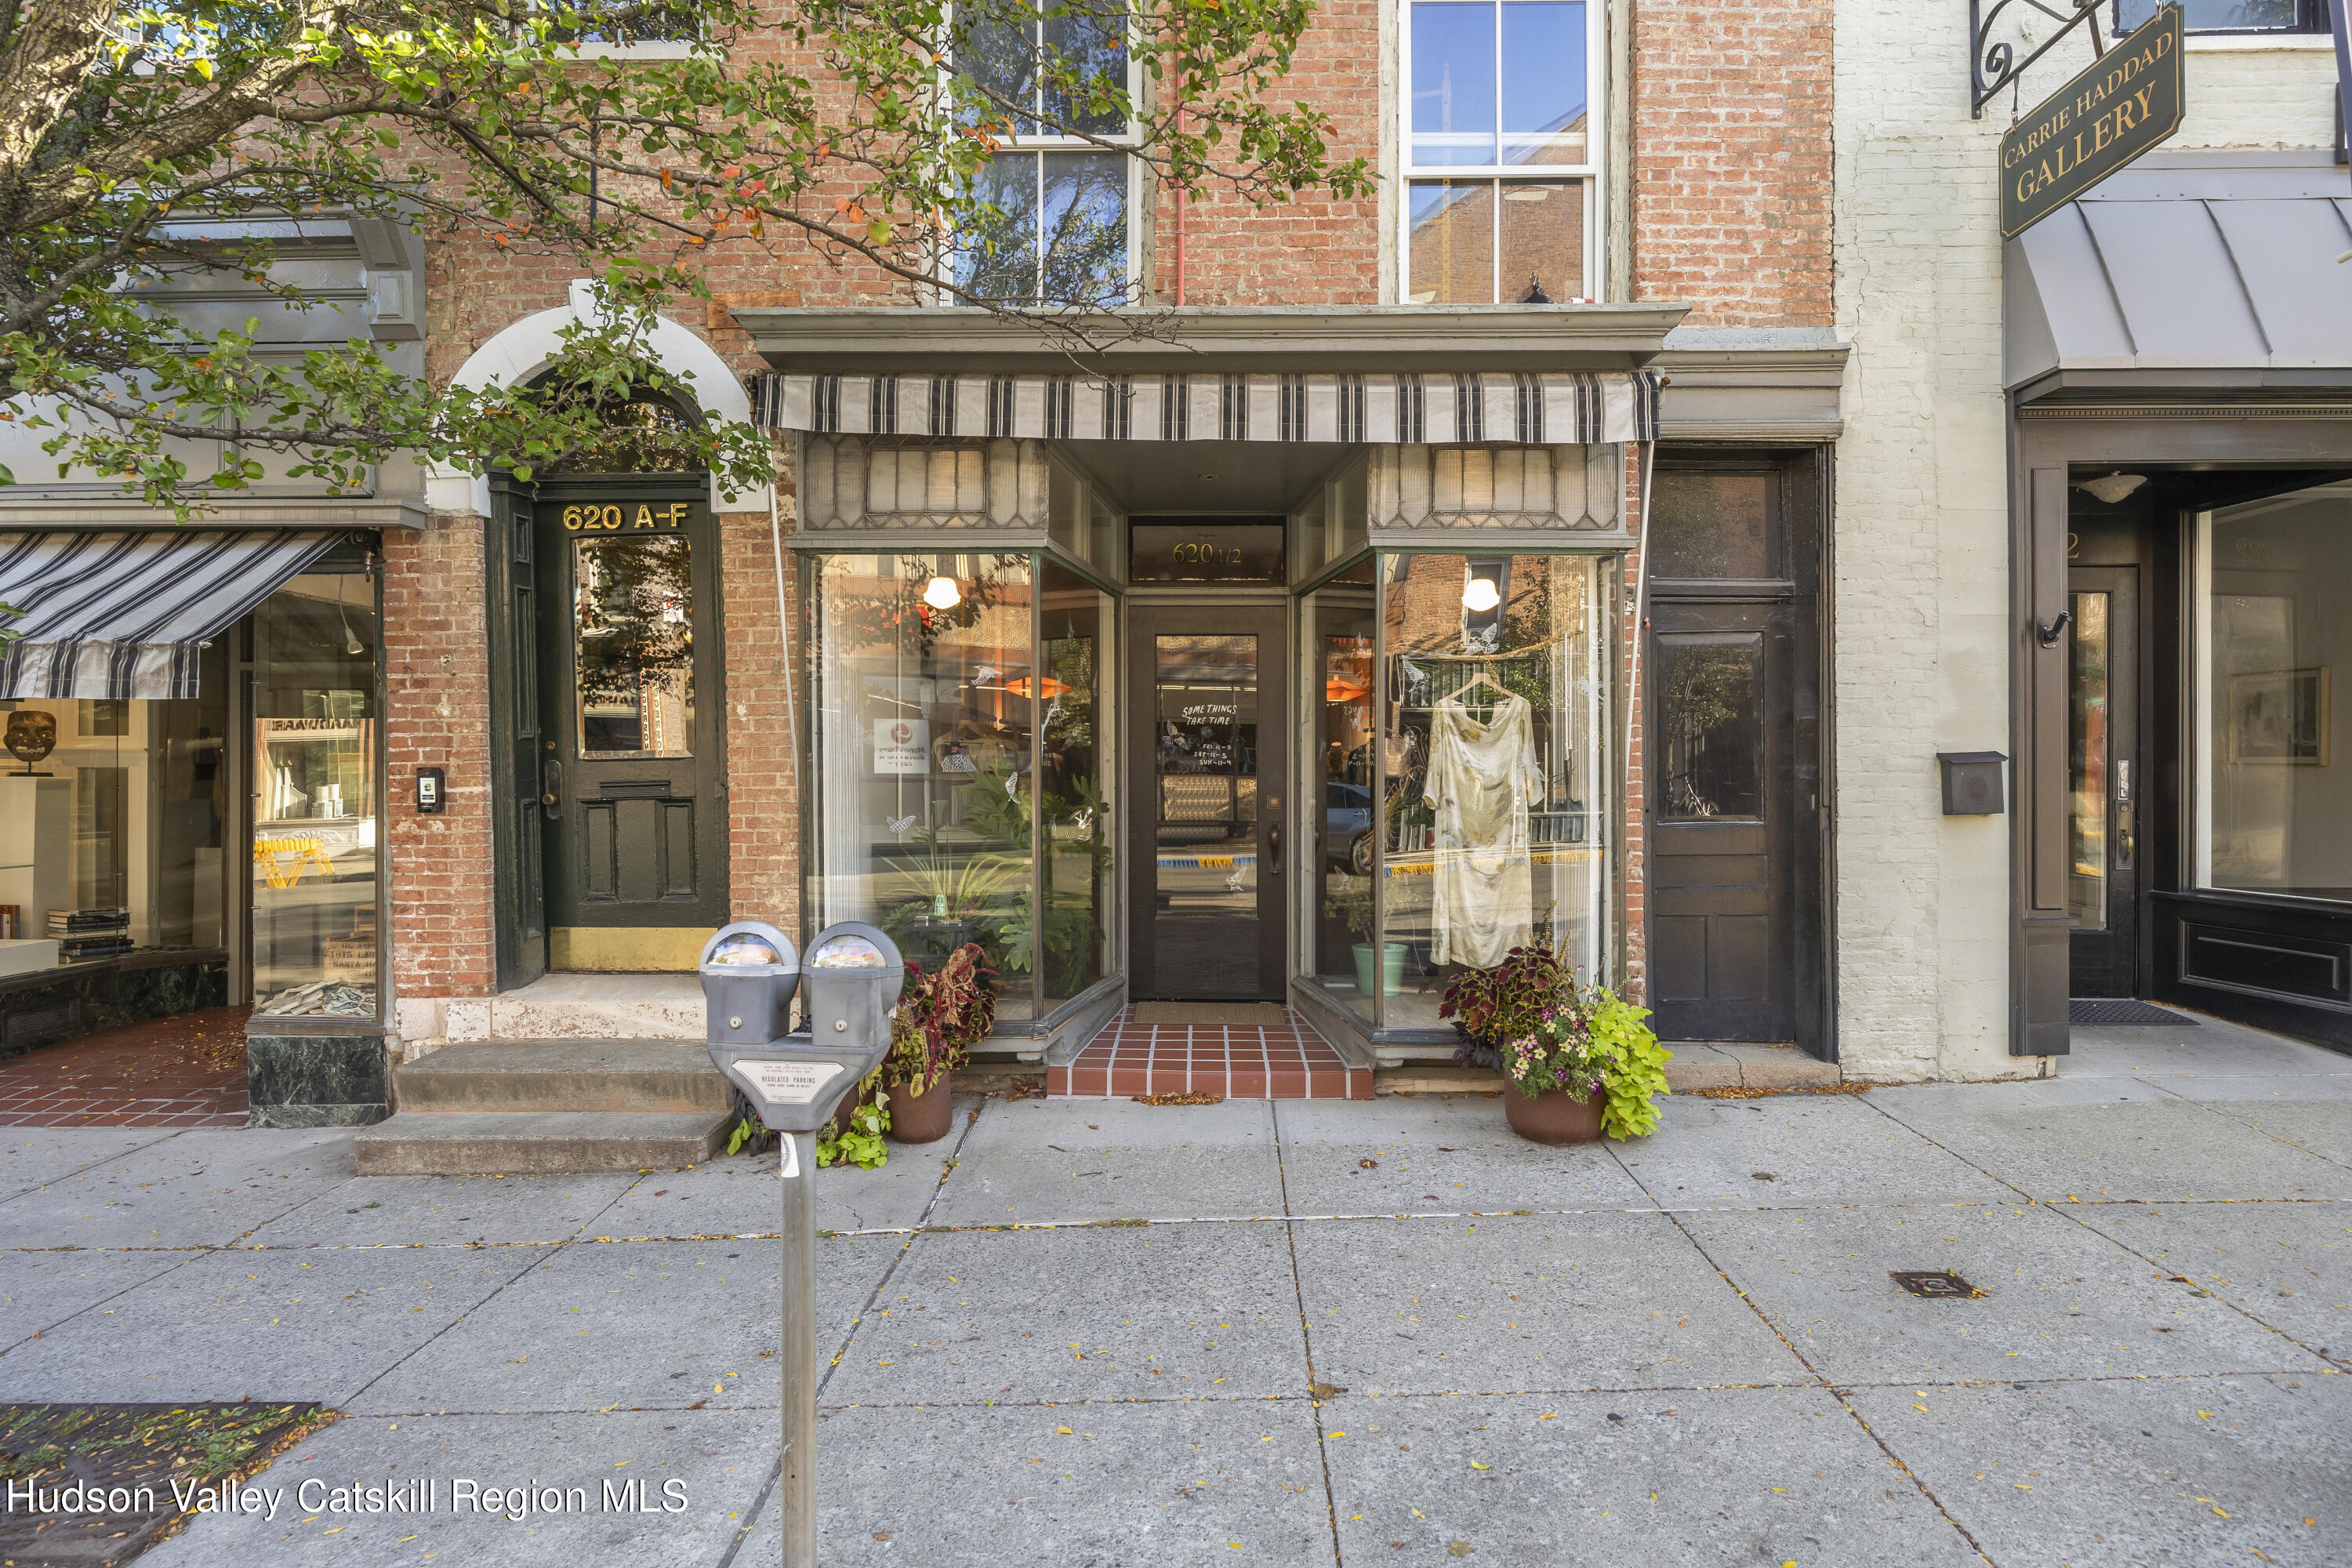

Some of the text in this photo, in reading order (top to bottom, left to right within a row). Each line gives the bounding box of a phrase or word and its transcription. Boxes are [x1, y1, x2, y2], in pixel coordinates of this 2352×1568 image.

[2004, 31, 2172, 169] CARRIE HADDAD
[2016, 80, 2156, 203] GALLERY
[563, 503, 689, 531] 620 A-F
[1172, 542, 1242, 564] 620 1/2
[1181, 704, 1237, 718] SOME THINGS
[1185, 716, 1230, 726] TAKE TIME
